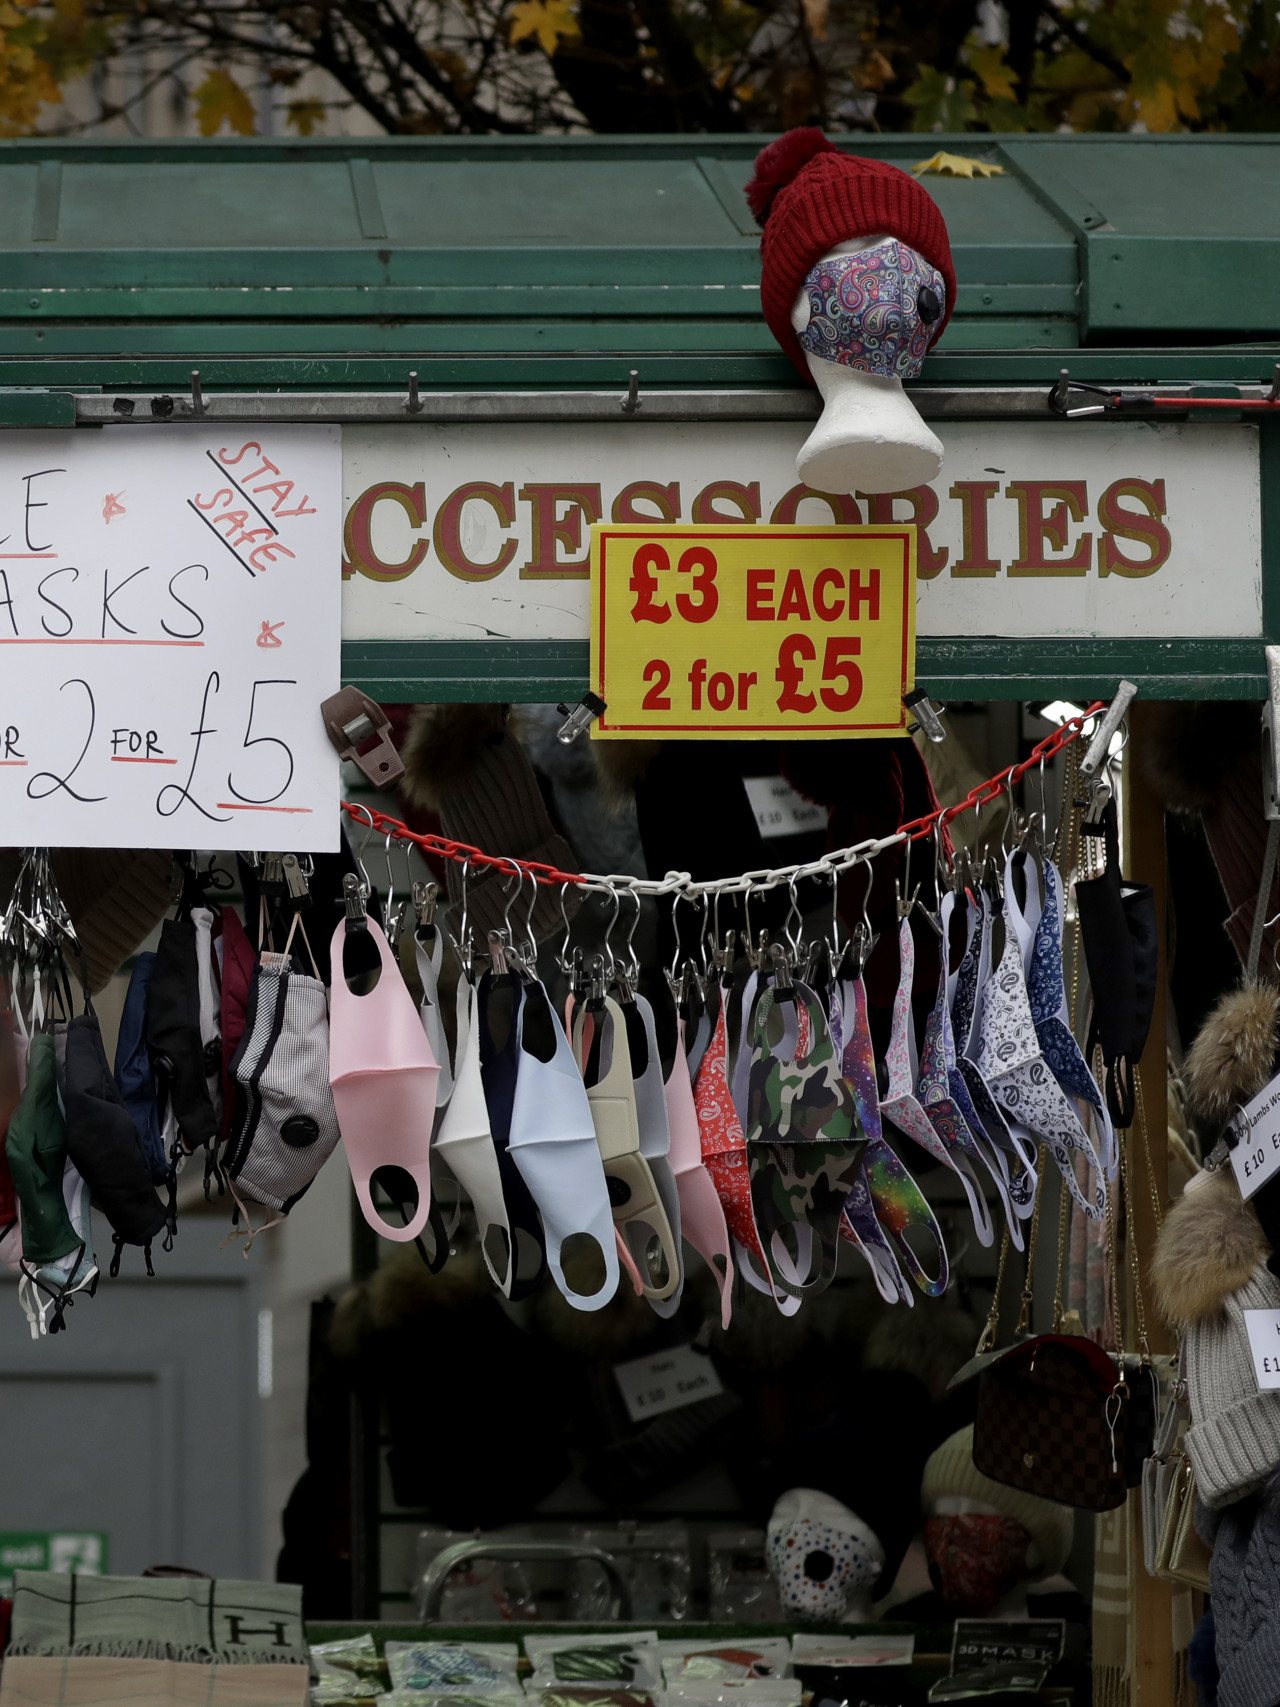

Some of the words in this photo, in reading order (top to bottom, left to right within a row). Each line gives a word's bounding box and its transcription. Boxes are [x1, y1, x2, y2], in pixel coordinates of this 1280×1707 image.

[218, 440, 317, 518] STAY
[342, 478, 1172, 583] CCERIES
[629, 543, 719, 625] £3
[746, 568, 881, 621] EACH
[642, 658, 671, 711] 2
[688, 658, 758, 712] for
[775, 632, 863, 714] £5
[26, 678, 108, 802] 2
[110, 727, 164, 760] FOR
[156, 670, 297, 822] £5
[959, 1645, 978, 1655] 3D
[981, 1645, 1055, 1659] MASK
